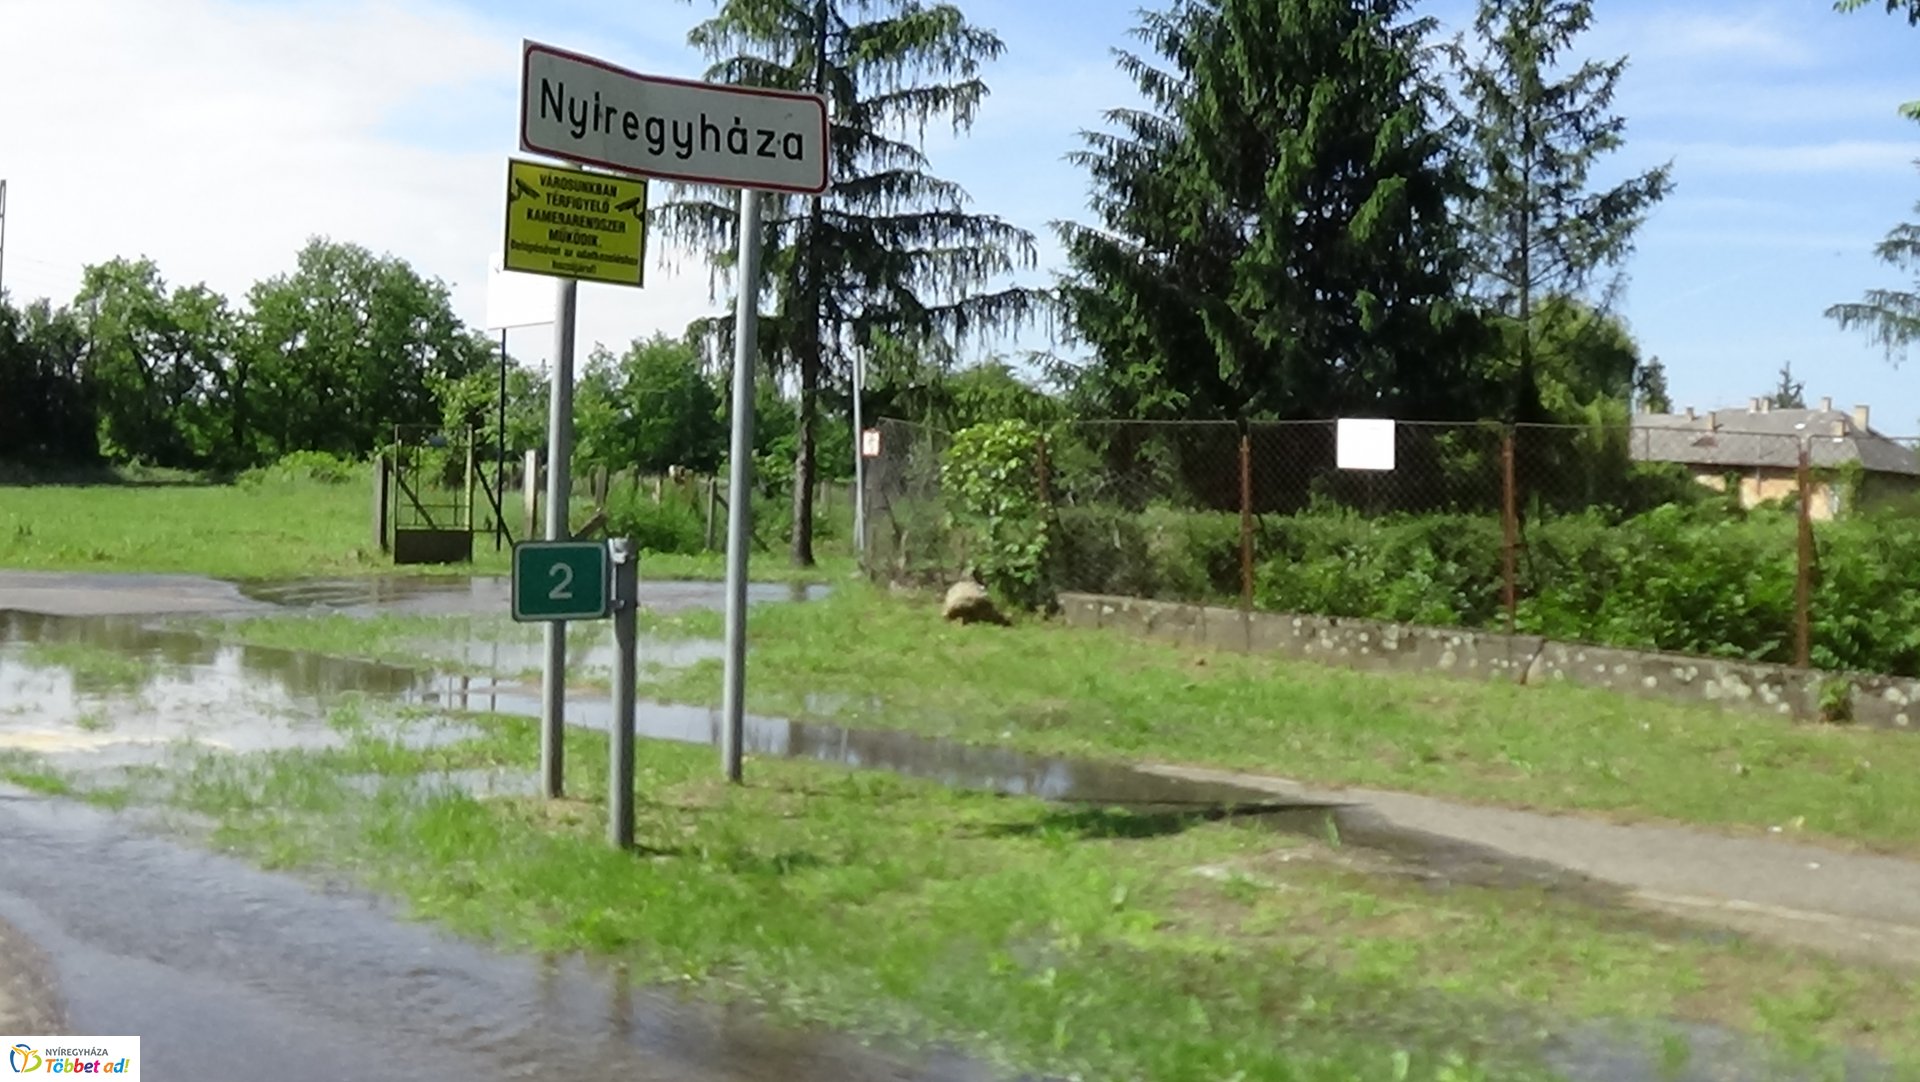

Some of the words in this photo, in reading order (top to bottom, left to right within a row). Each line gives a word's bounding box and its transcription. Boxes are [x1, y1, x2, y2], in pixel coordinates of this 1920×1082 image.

[541, 79, 803, 160] Nyíregyháza
[539, 173, 617, 198] VÁROSUNKBAN
[527, 207, 626, 234] KAMERARENDSZER
[548, 562, 573, 599] 2
